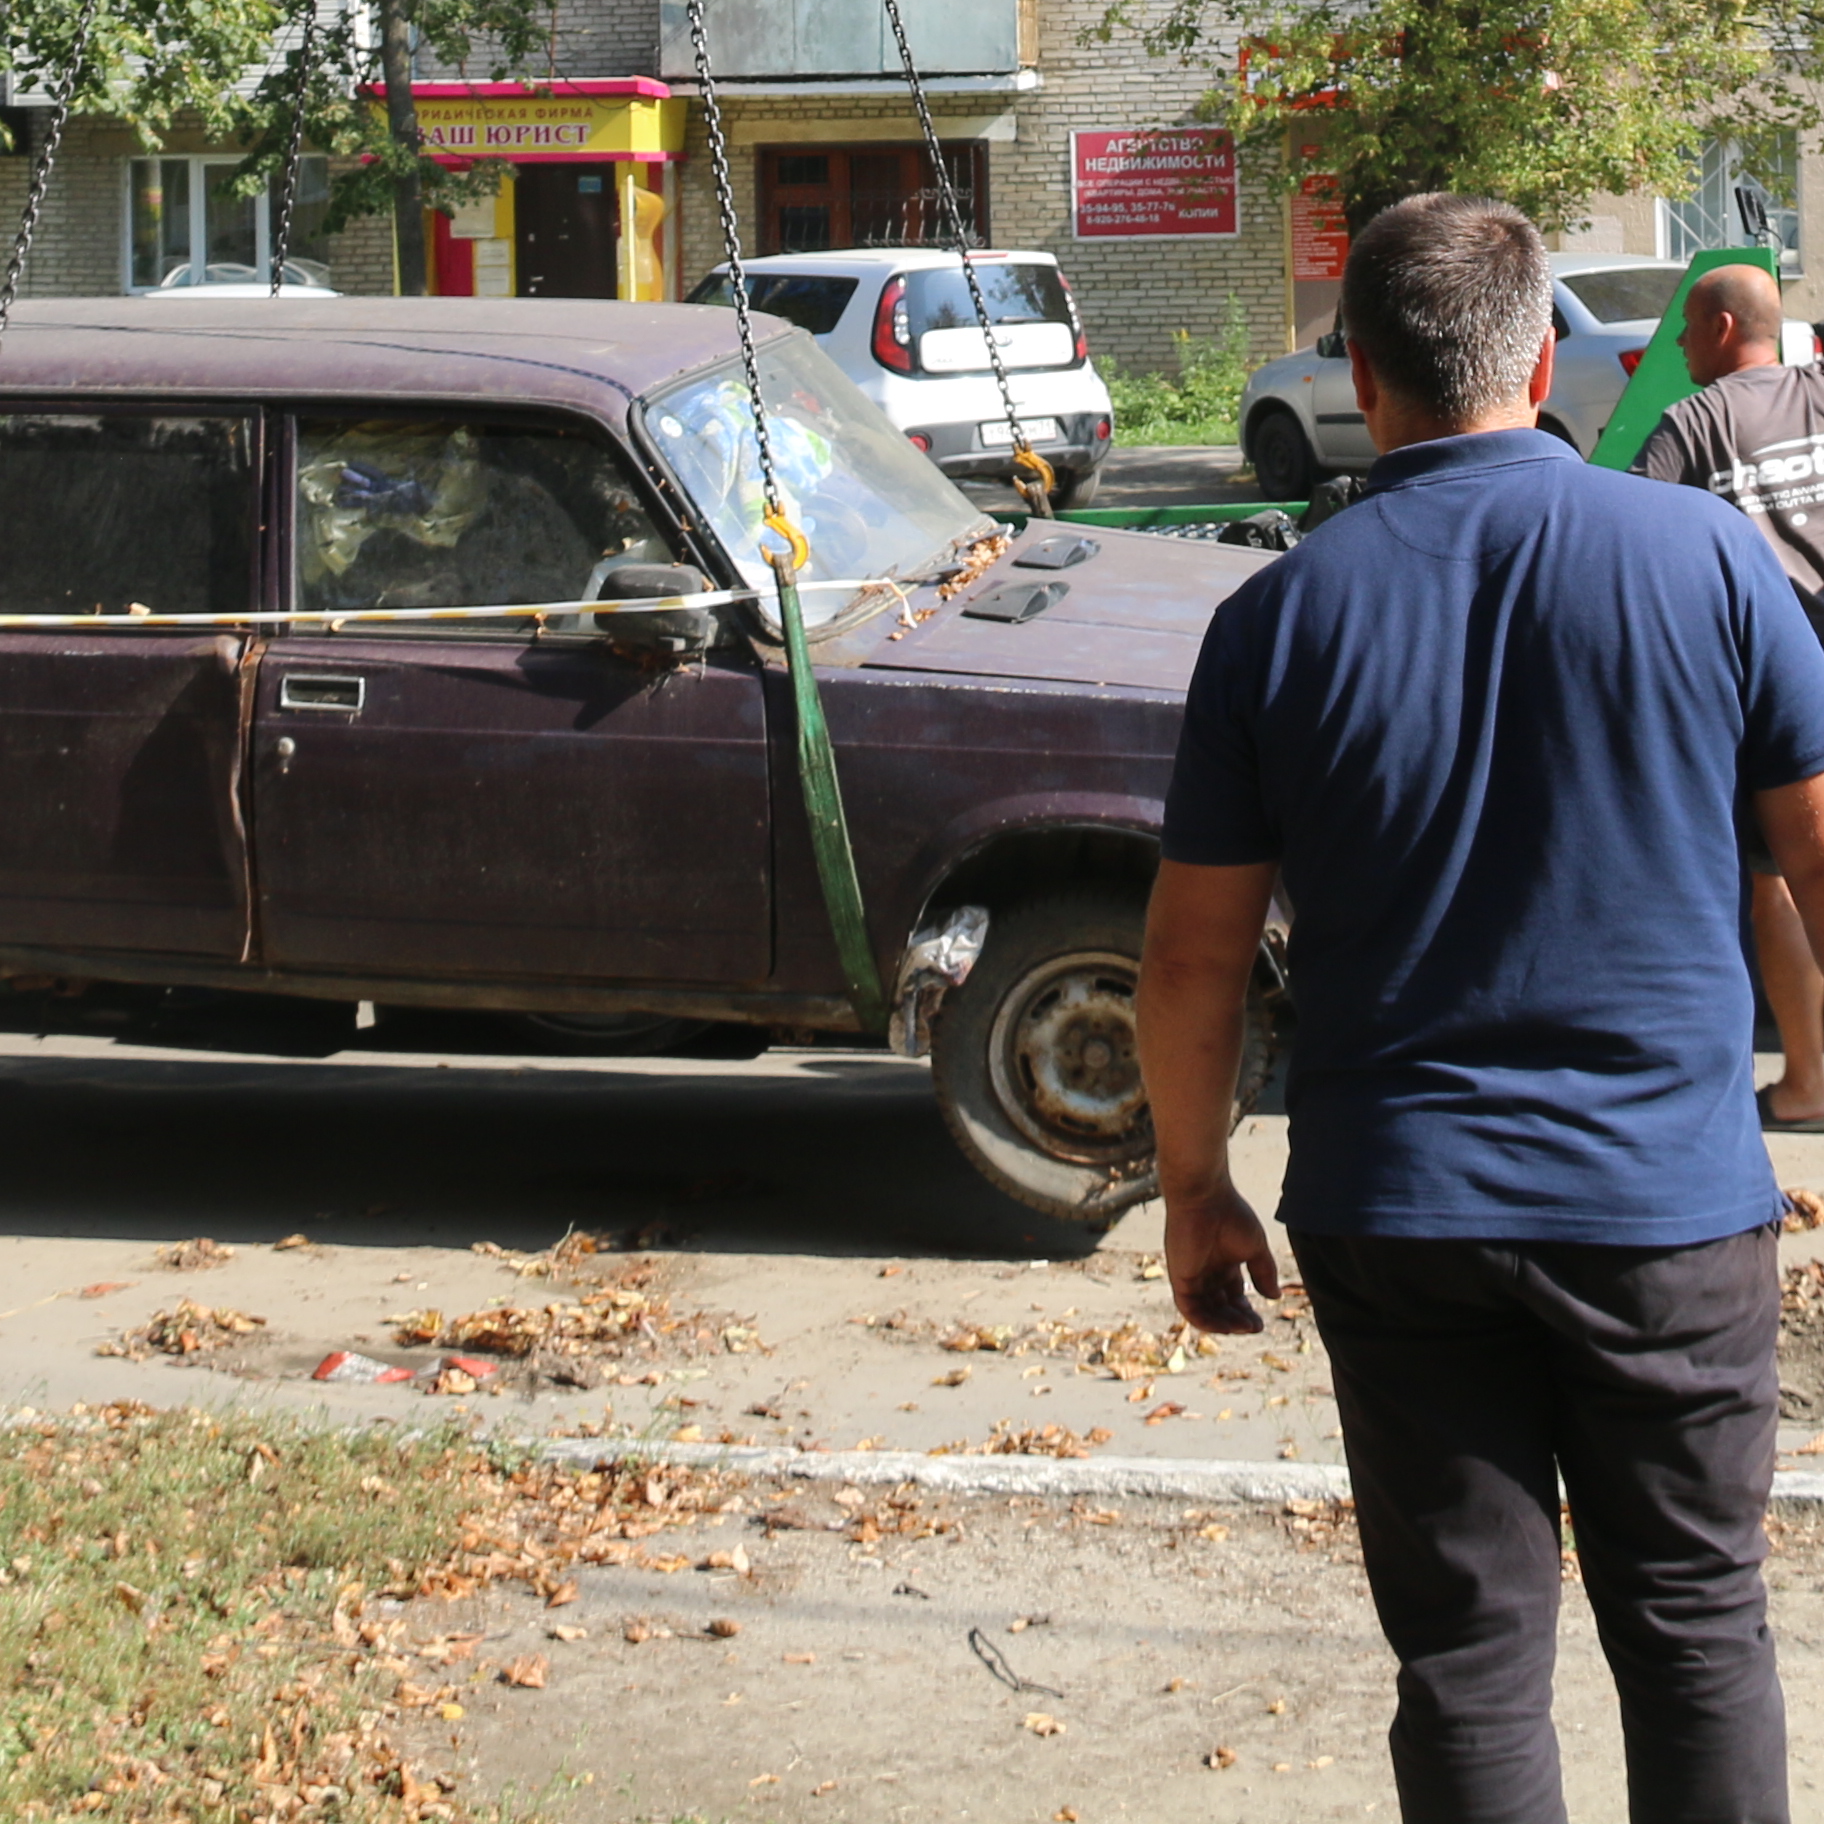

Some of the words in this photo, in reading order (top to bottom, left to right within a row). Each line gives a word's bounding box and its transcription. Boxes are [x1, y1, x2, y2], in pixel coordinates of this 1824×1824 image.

[535, 107, 593, 119] ФИРМА
[486, 123, 590, 146] ЮРИСТ
[1085, 155, 1225, 173] НЕДВИЖИМОСТИ
